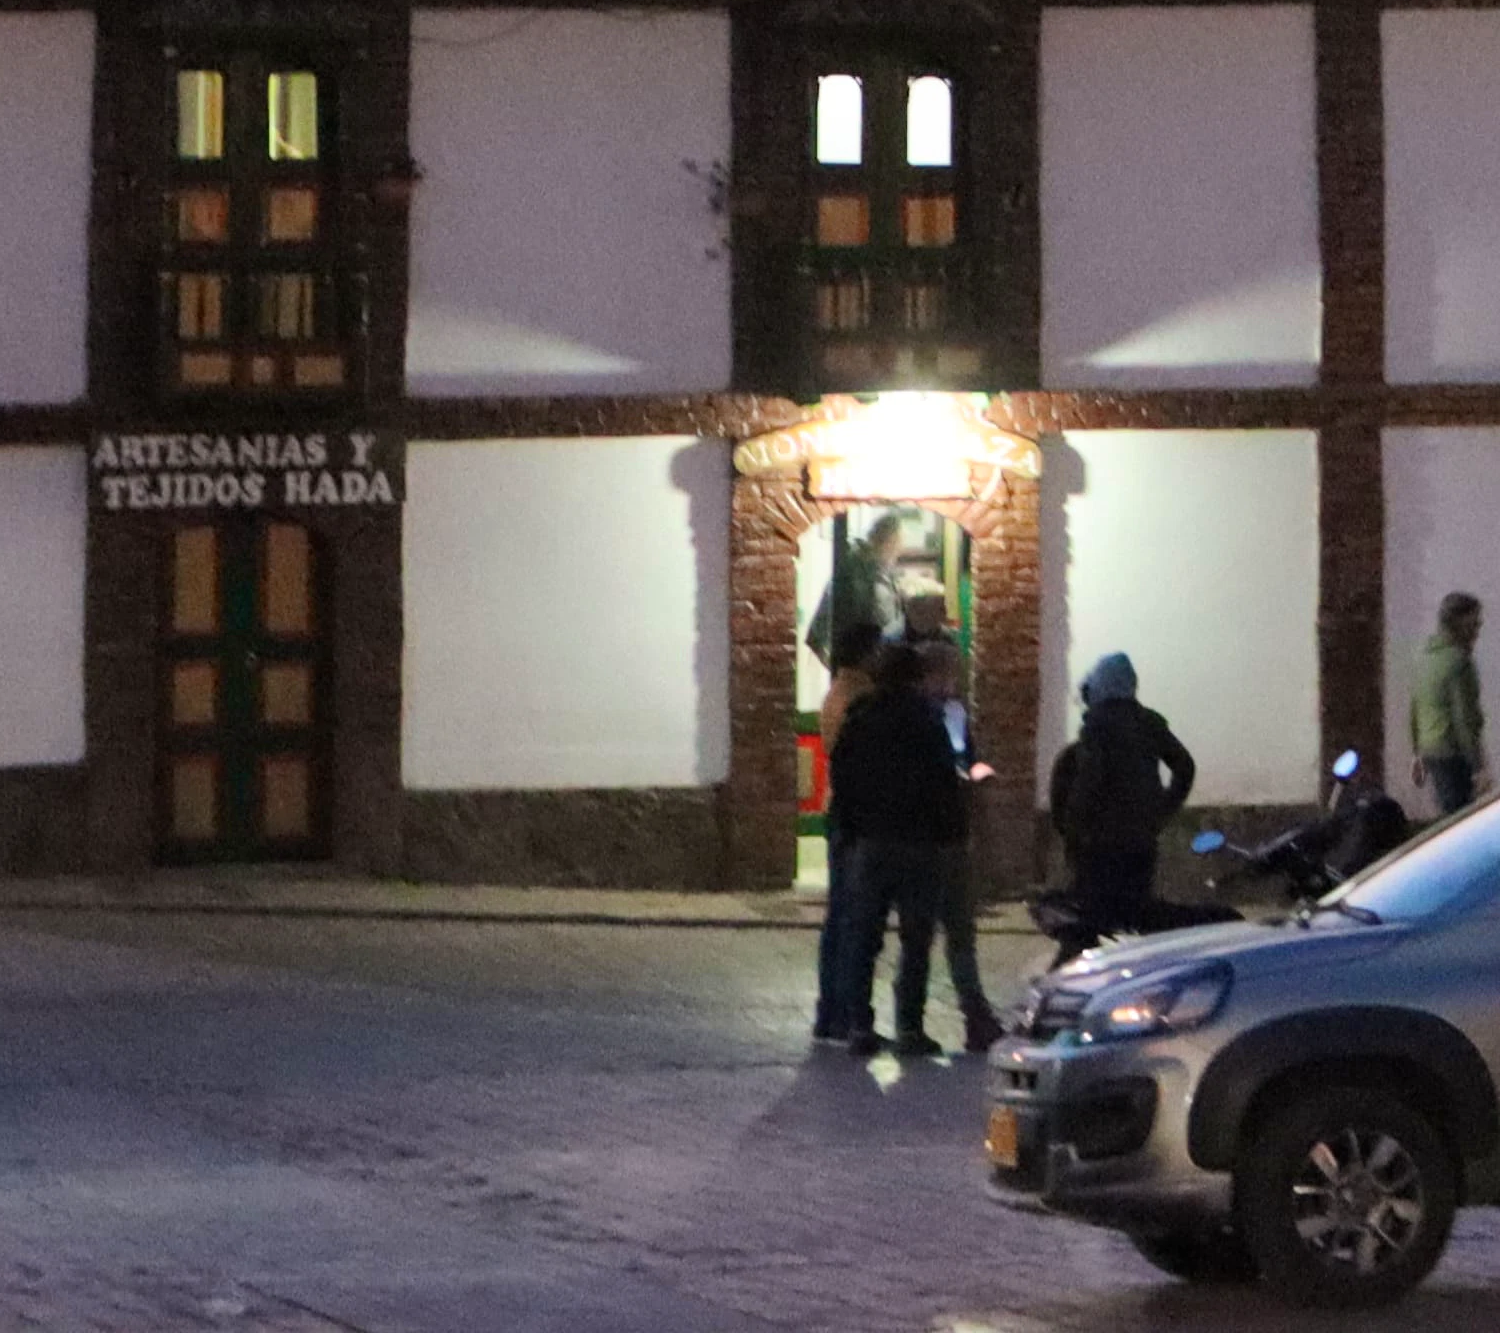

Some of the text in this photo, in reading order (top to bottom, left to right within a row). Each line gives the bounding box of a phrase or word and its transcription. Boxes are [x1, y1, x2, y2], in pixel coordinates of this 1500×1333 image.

[95, 434, 376, 469] ARTESANIAS Y
[104, 469, 394, 509] TEJIDOS HADA
